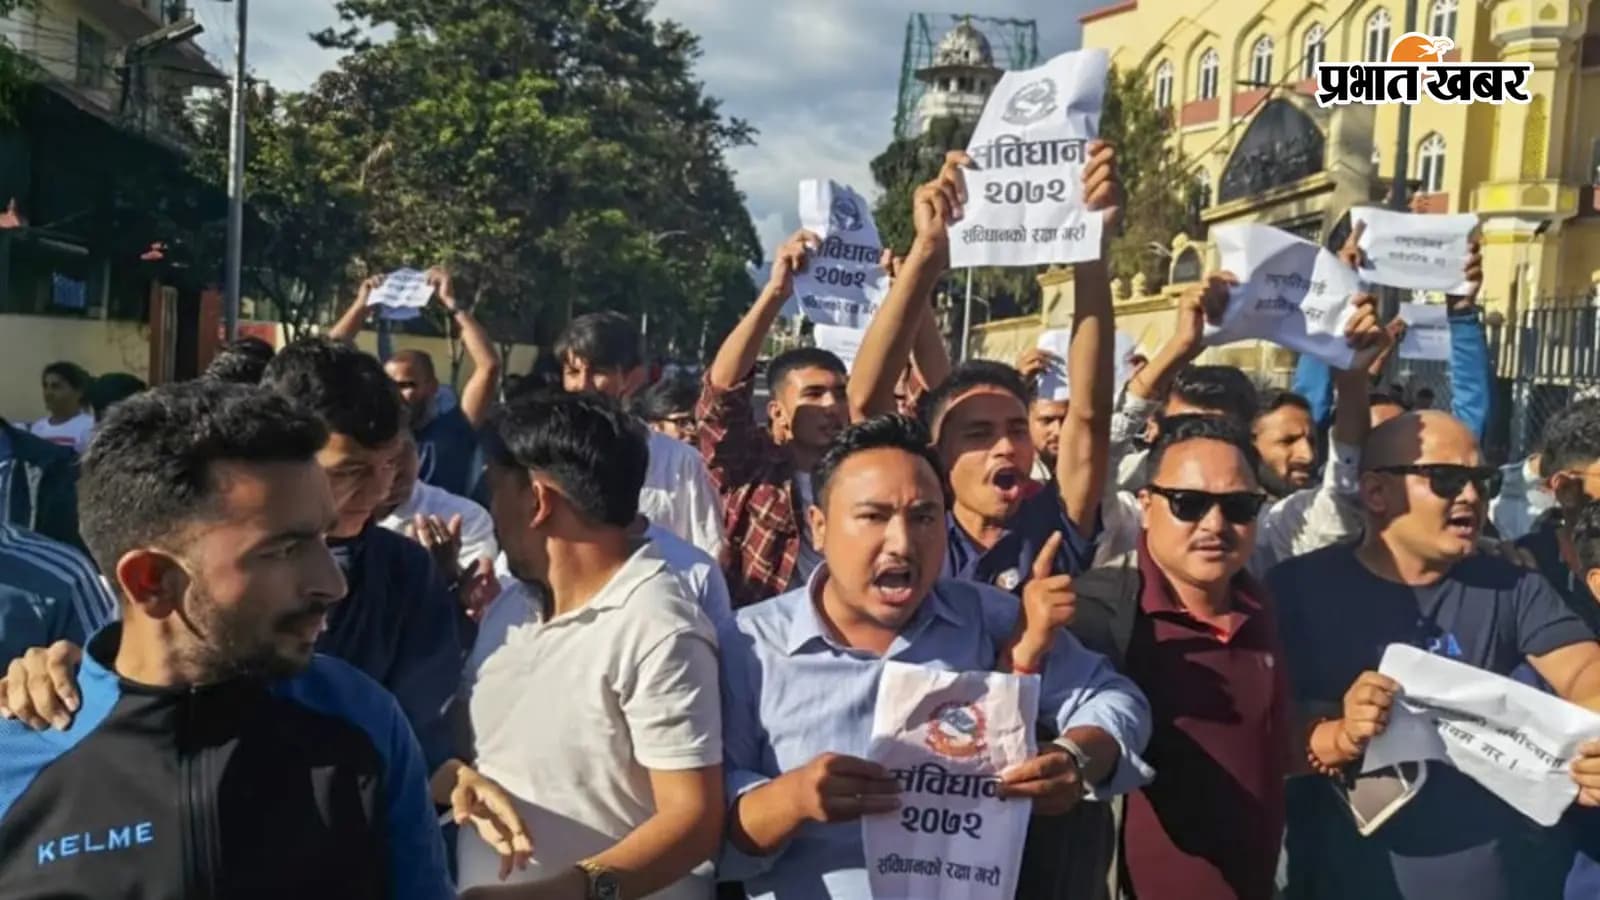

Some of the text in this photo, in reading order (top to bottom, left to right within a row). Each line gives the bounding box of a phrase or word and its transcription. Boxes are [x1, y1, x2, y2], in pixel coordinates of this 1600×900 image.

[984, 179, 1066, 204] २०७२
[962, 224, 1026, 245] संविधानको
[1031, 228, 1057, 243] रक्षा
[814, 266, 867, 288] २०७२
[1480, 742, 1505, 763] गर
[901, 806, 982, 839] २०७२
[37, 821, 154, 865] KELME
[877, 853, 942, 877] संविधानको
[945, 862, 971, 882] रक्षा
